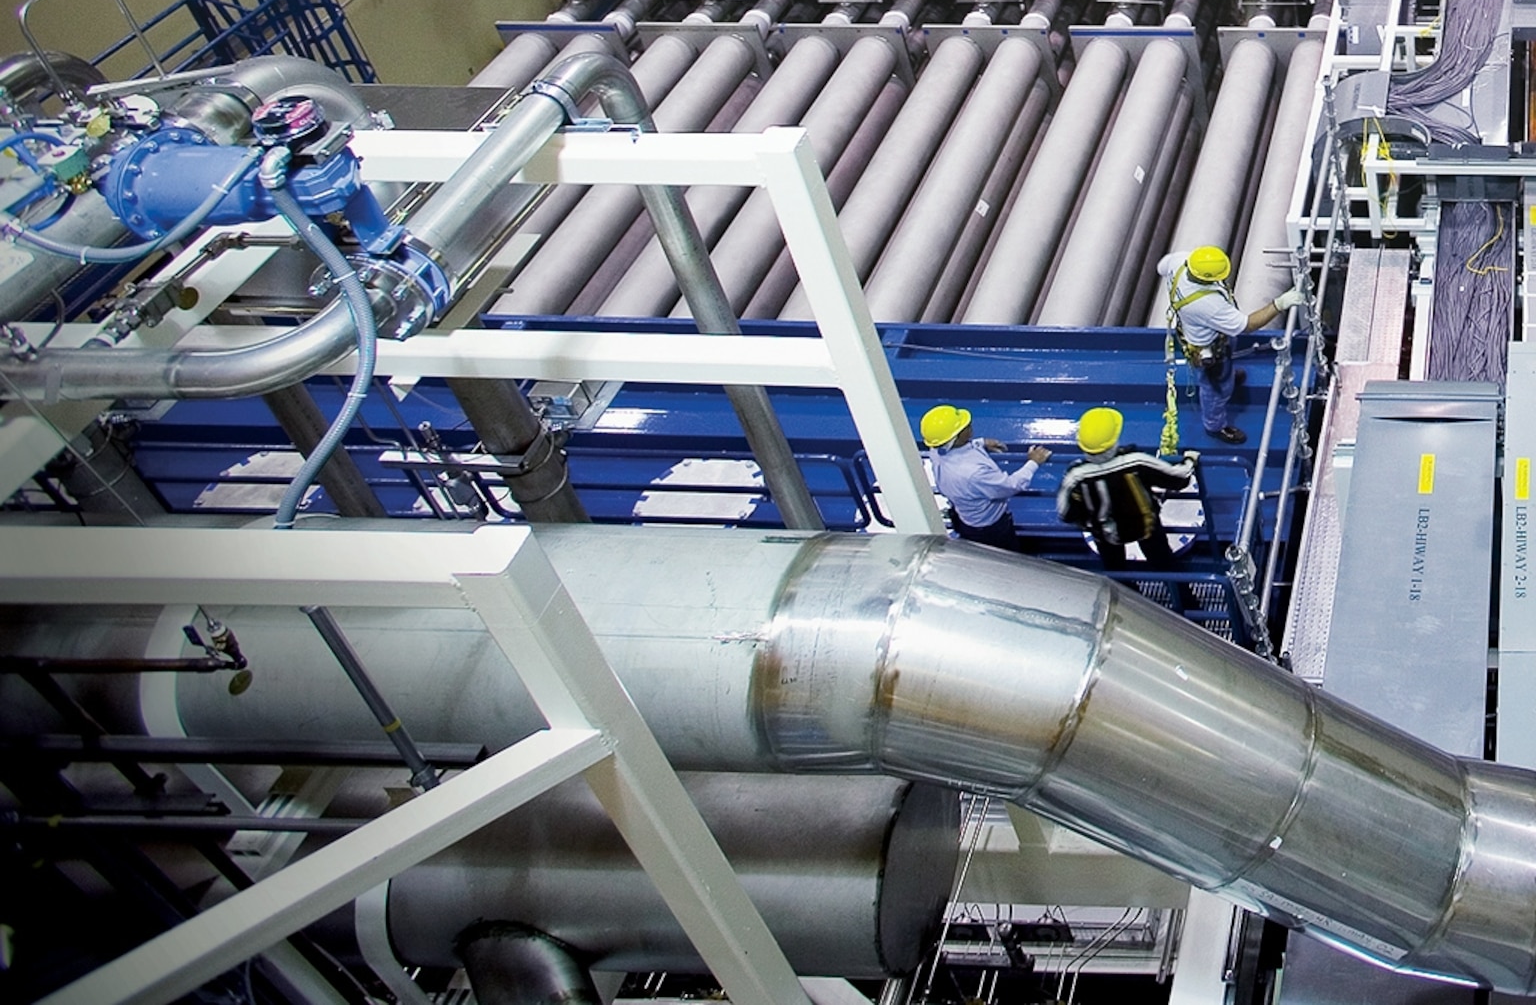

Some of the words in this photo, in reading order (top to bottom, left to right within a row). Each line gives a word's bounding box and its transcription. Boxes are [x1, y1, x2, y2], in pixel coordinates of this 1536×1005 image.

[1412, 508, 1430, 575] LB2-HIWAY
[1515, 506, 1528, 574] LB2-HIWAY
[1409, 579, 1422, 601] 1-18
[1514, 576, 1527, 599] 2-18
